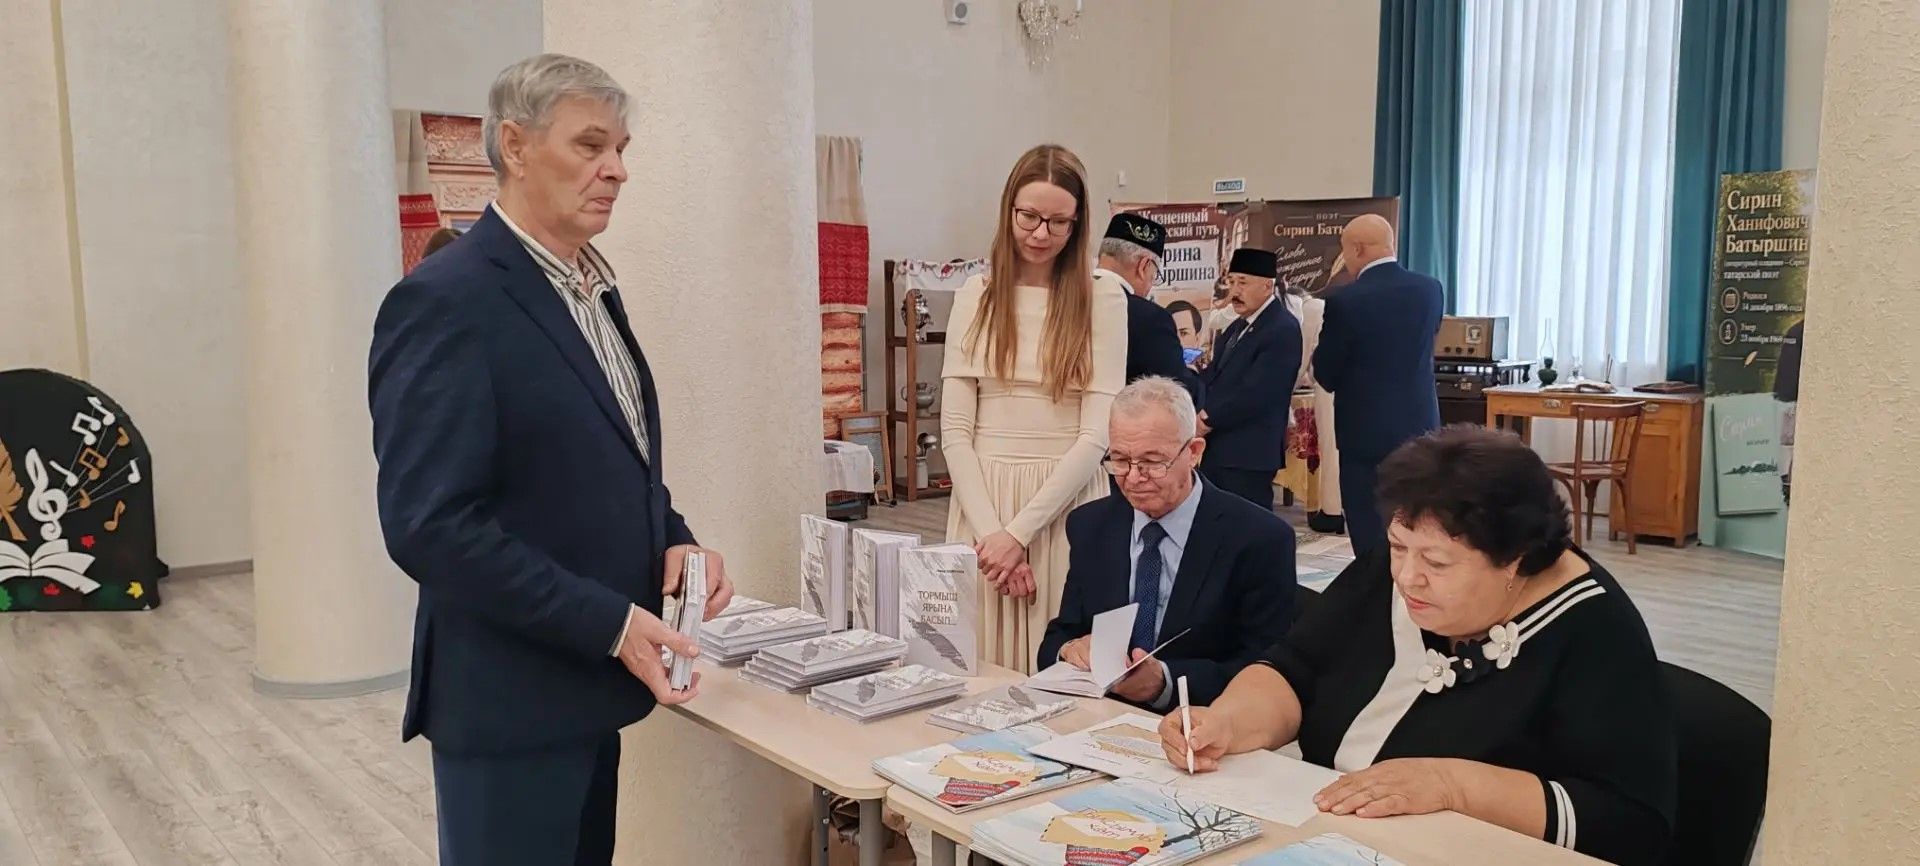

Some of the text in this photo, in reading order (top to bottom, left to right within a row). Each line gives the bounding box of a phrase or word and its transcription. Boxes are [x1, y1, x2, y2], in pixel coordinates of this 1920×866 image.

[1727, 190, 1782, 214] Сирин
[1196, 225, 1220, 239] путь
[1274, 224, 1314, 239] Сирин
[1726, 213, 1809, 235] Ханифович
[1725, 234, 1809, 257] Батыршин
[1163, 247, 1201, 267] рина
[918, 590, 958, 601] ТОРМЫШ
[922, 603, 953, 613] ЯРЫНА
